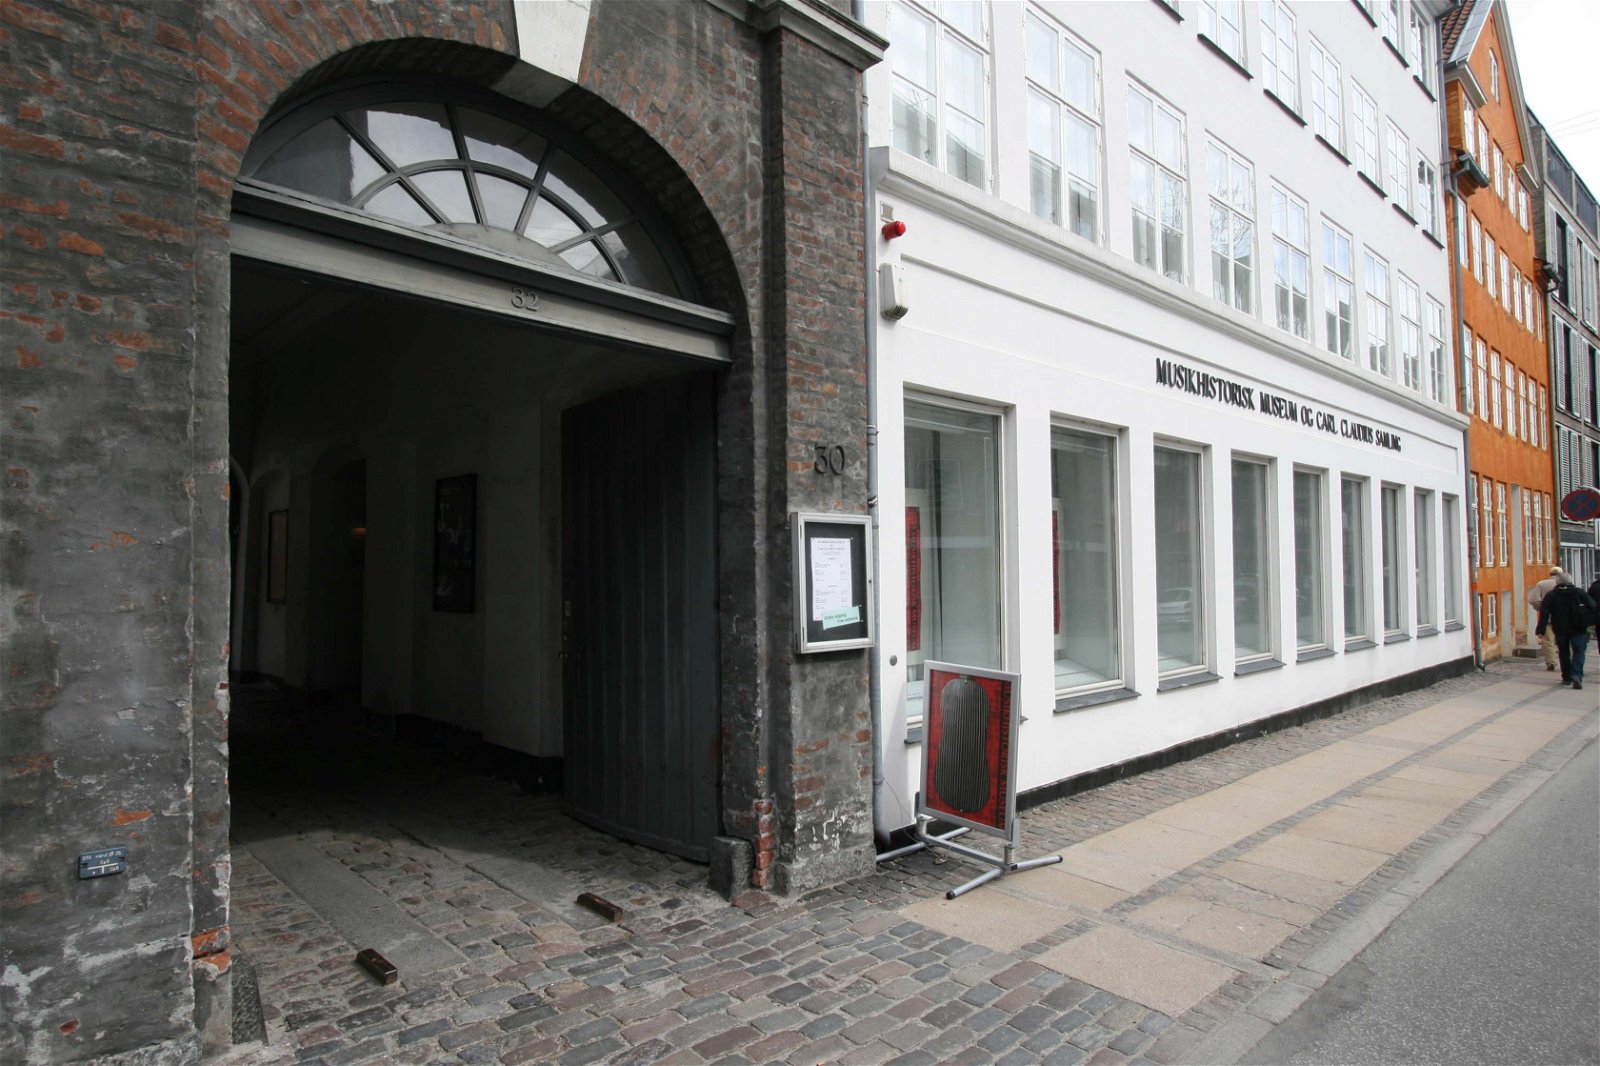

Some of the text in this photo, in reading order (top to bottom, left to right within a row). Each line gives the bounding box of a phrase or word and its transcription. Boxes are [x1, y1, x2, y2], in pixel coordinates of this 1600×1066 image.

[511, 286, 540, 312] 32
[1155, 357, 1402, 453] MUSIKHISTORISK MUSEUM OG CARL CLAUDIUS SAMLING
[813, 442, 845, 476] 30
